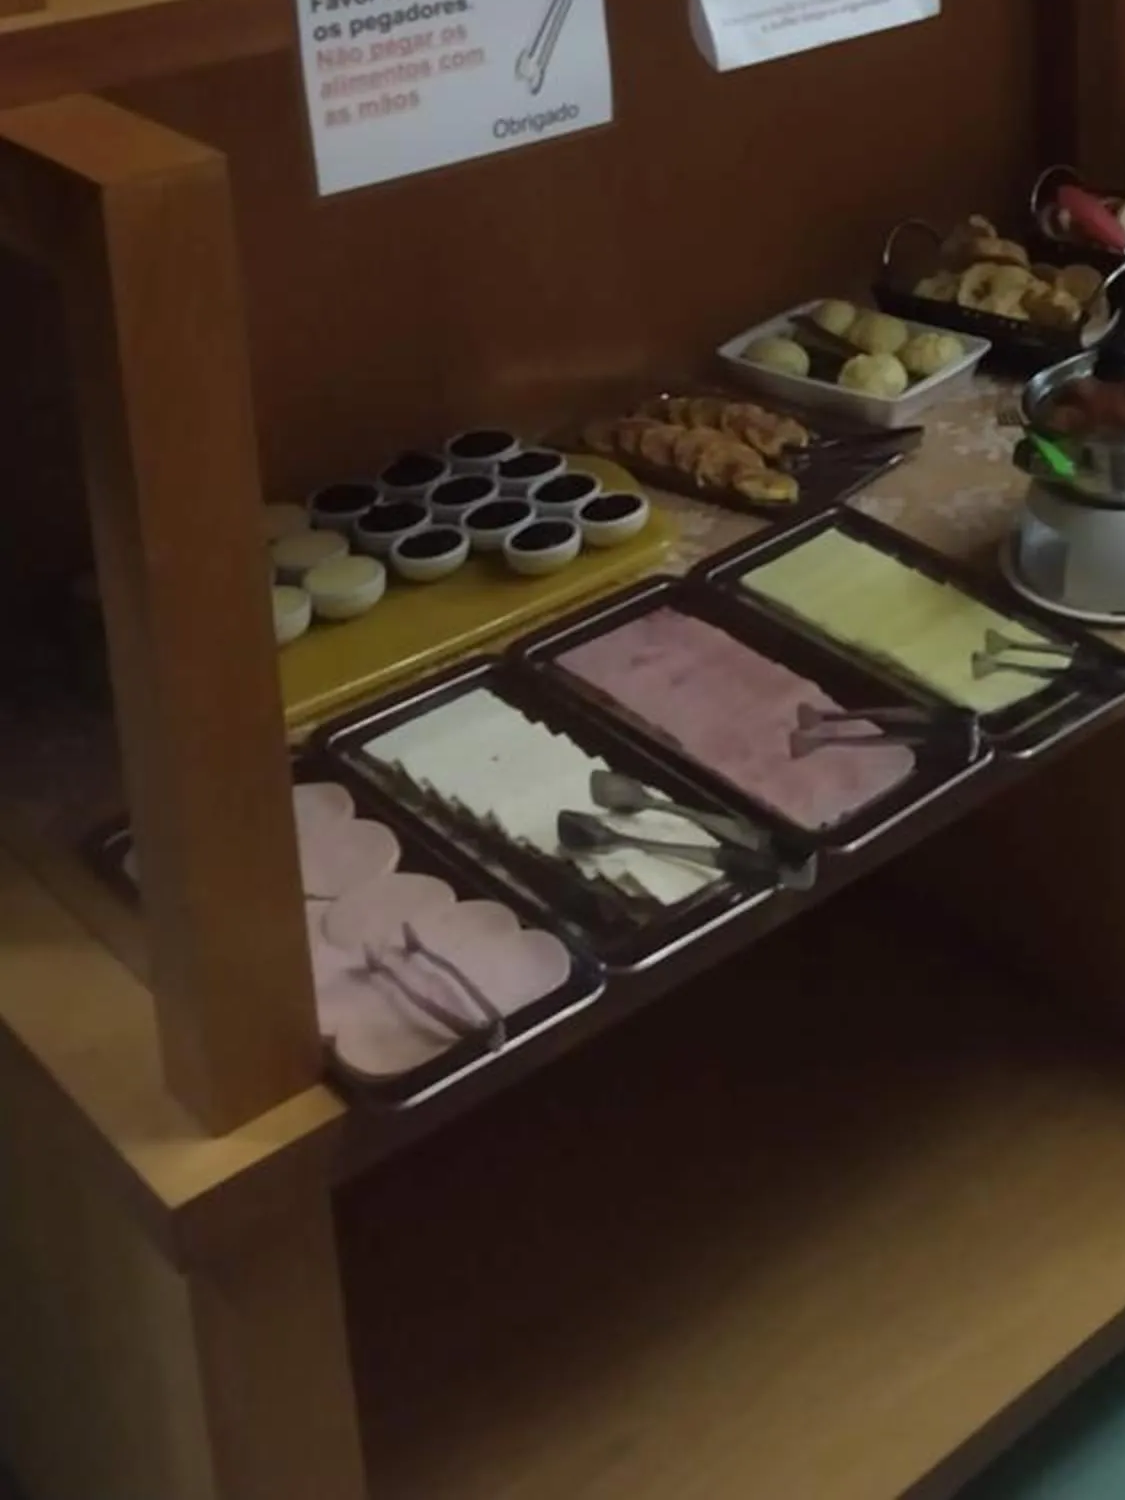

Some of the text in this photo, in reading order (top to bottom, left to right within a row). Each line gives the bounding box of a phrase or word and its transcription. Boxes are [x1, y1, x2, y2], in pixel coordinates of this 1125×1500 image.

[313, 22, 342, 42] os
[370, 30, 435, 62] pegar
[440, 24, 468, 43] os
[321, 48, 486, 99] alimentos com
[325, 107, 351, 126] as
[492, 101, 580, 138] Obrigado
